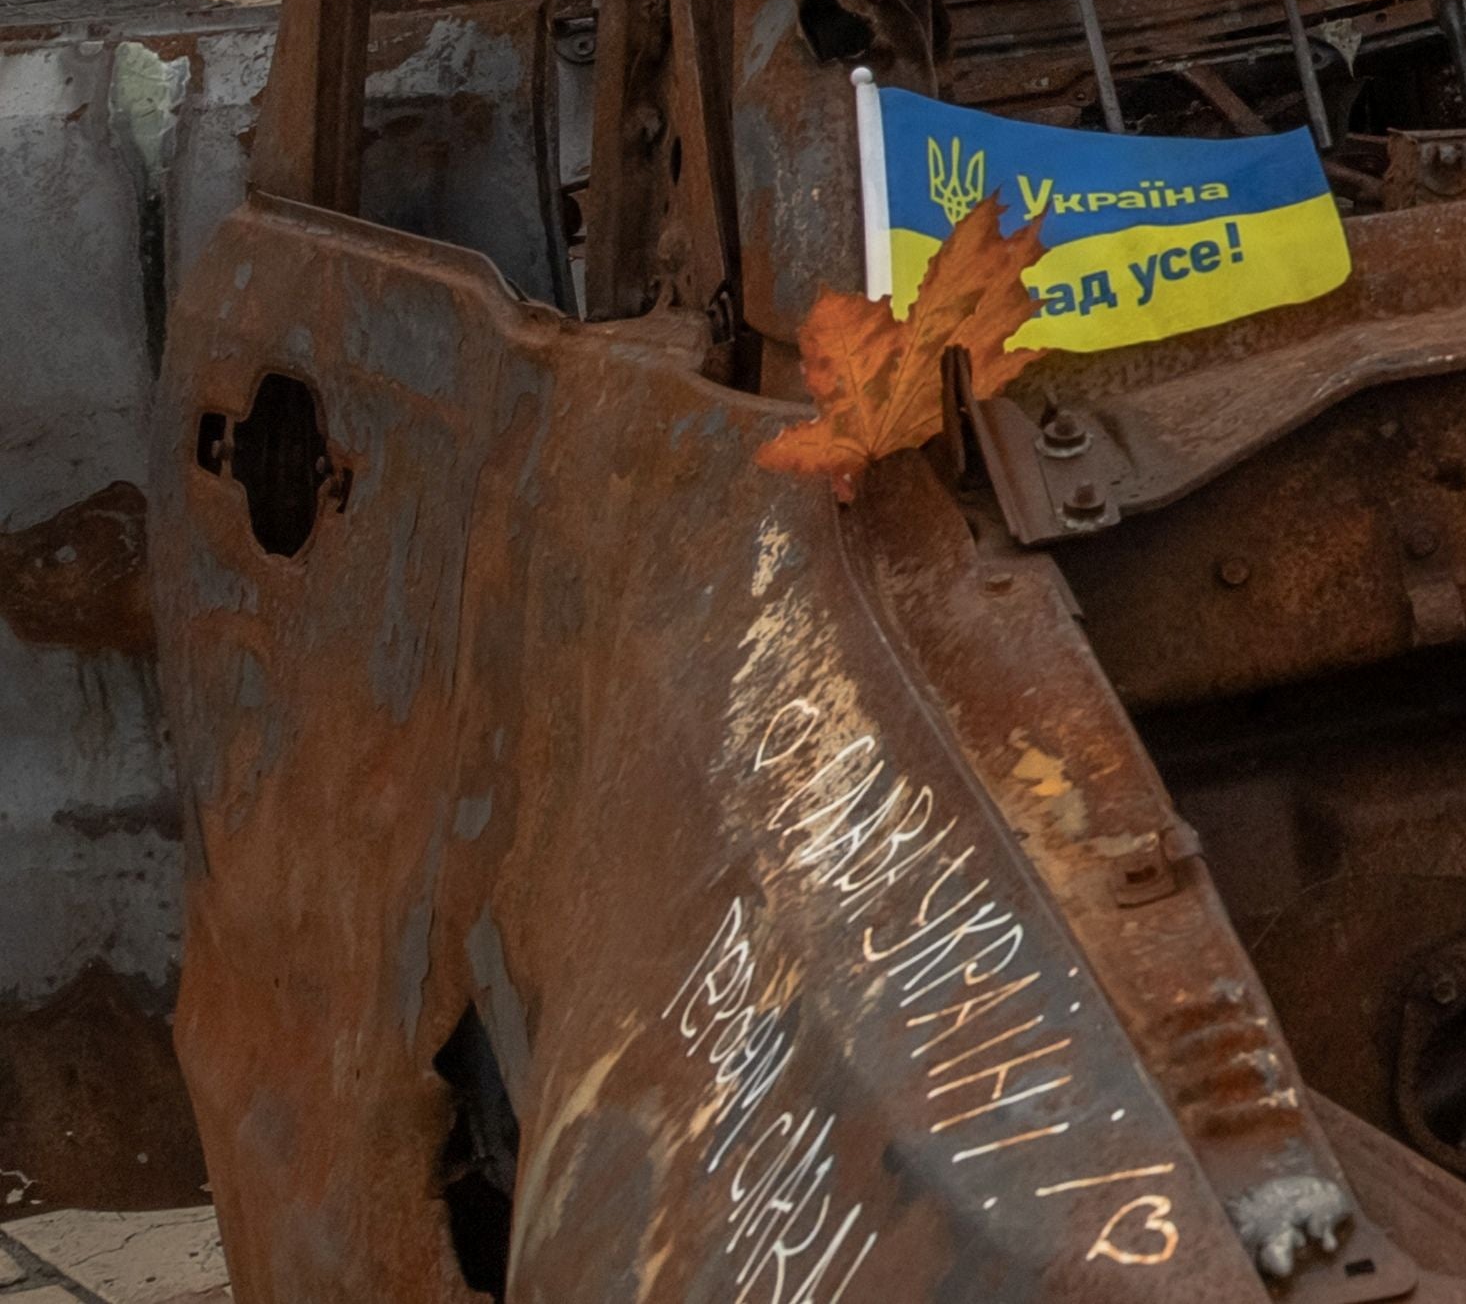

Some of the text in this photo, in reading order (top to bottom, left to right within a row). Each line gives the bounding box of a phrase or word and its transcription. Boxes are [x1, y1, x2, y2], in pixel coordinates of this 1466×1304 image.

[1016, 174, 1231, 221] Україна
[1128, 221, 1246, 302] усе!
[766, 735, 958, 925] СЛАВА
